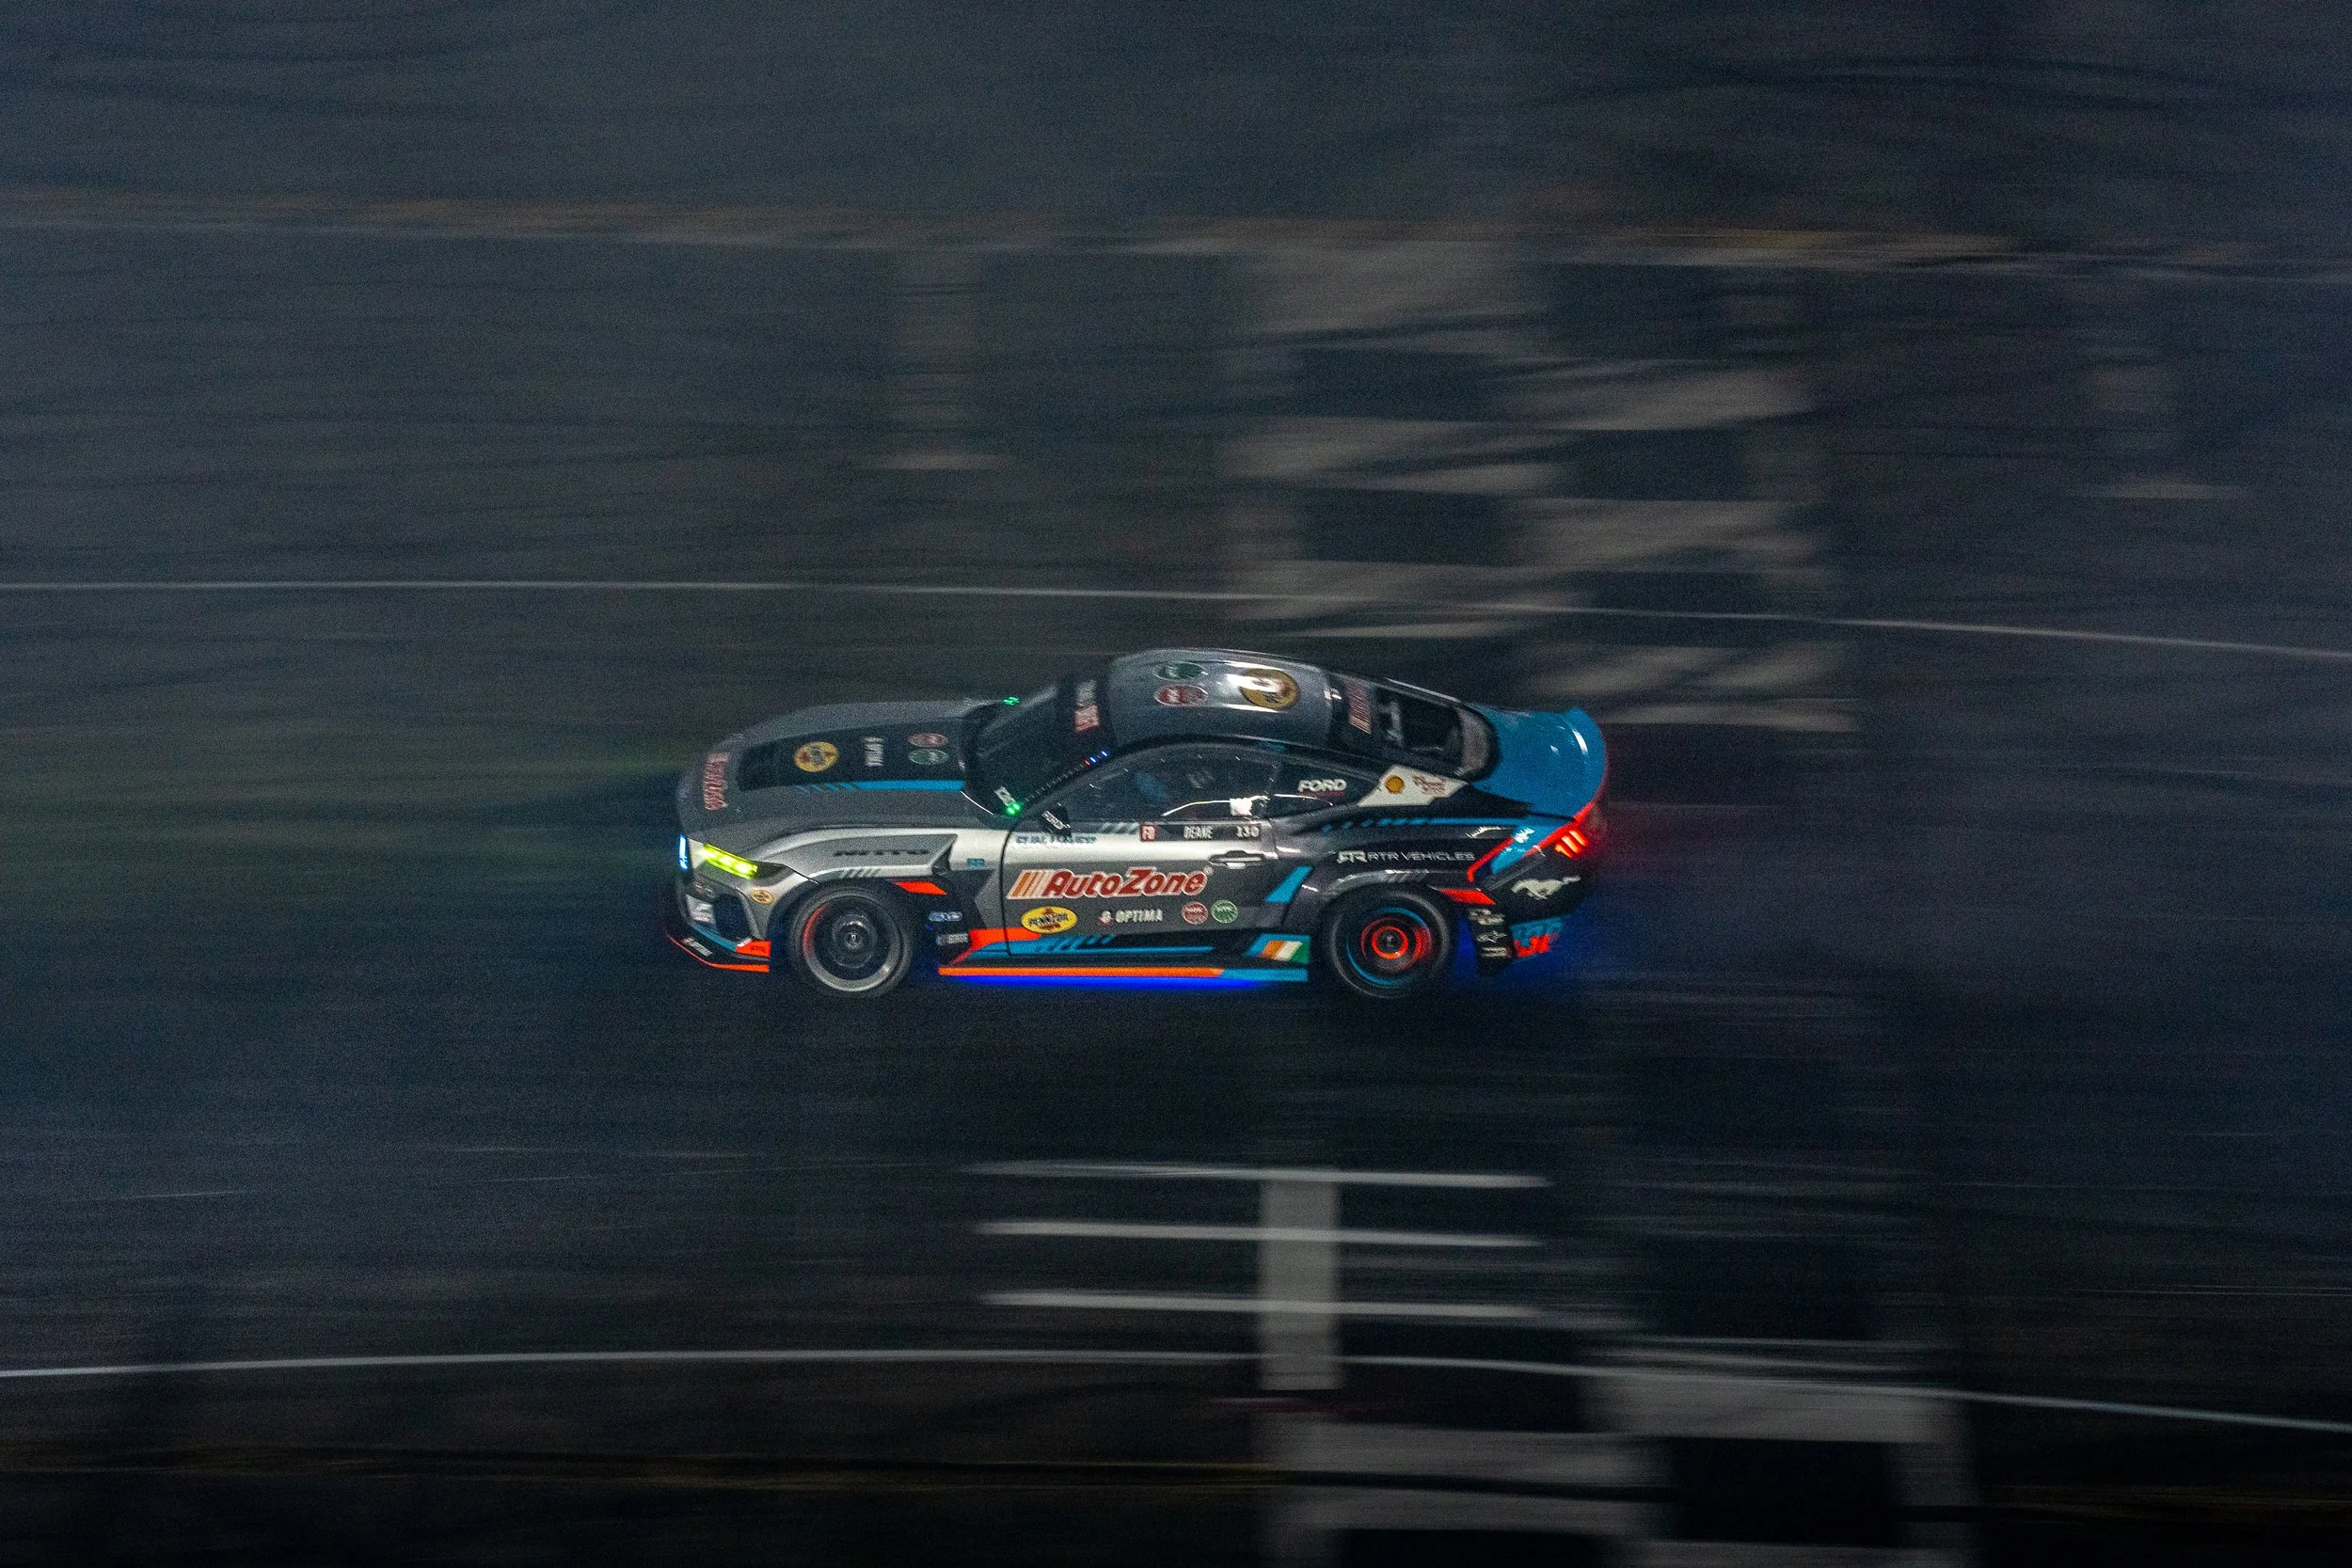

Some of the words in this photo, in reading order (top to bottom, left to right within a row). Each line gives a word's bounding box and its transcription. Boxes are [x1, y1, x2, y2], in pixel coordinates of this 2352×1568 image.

[1297, 779, 1347, 792] FORD
[1367, 851, 1400, 862] RTR
[1400, 851, 1475, 862] VEHICLES
[1041, 867, 1208, 898] AutoZone
[1115, 909, 1164, 924] OPTIMA
